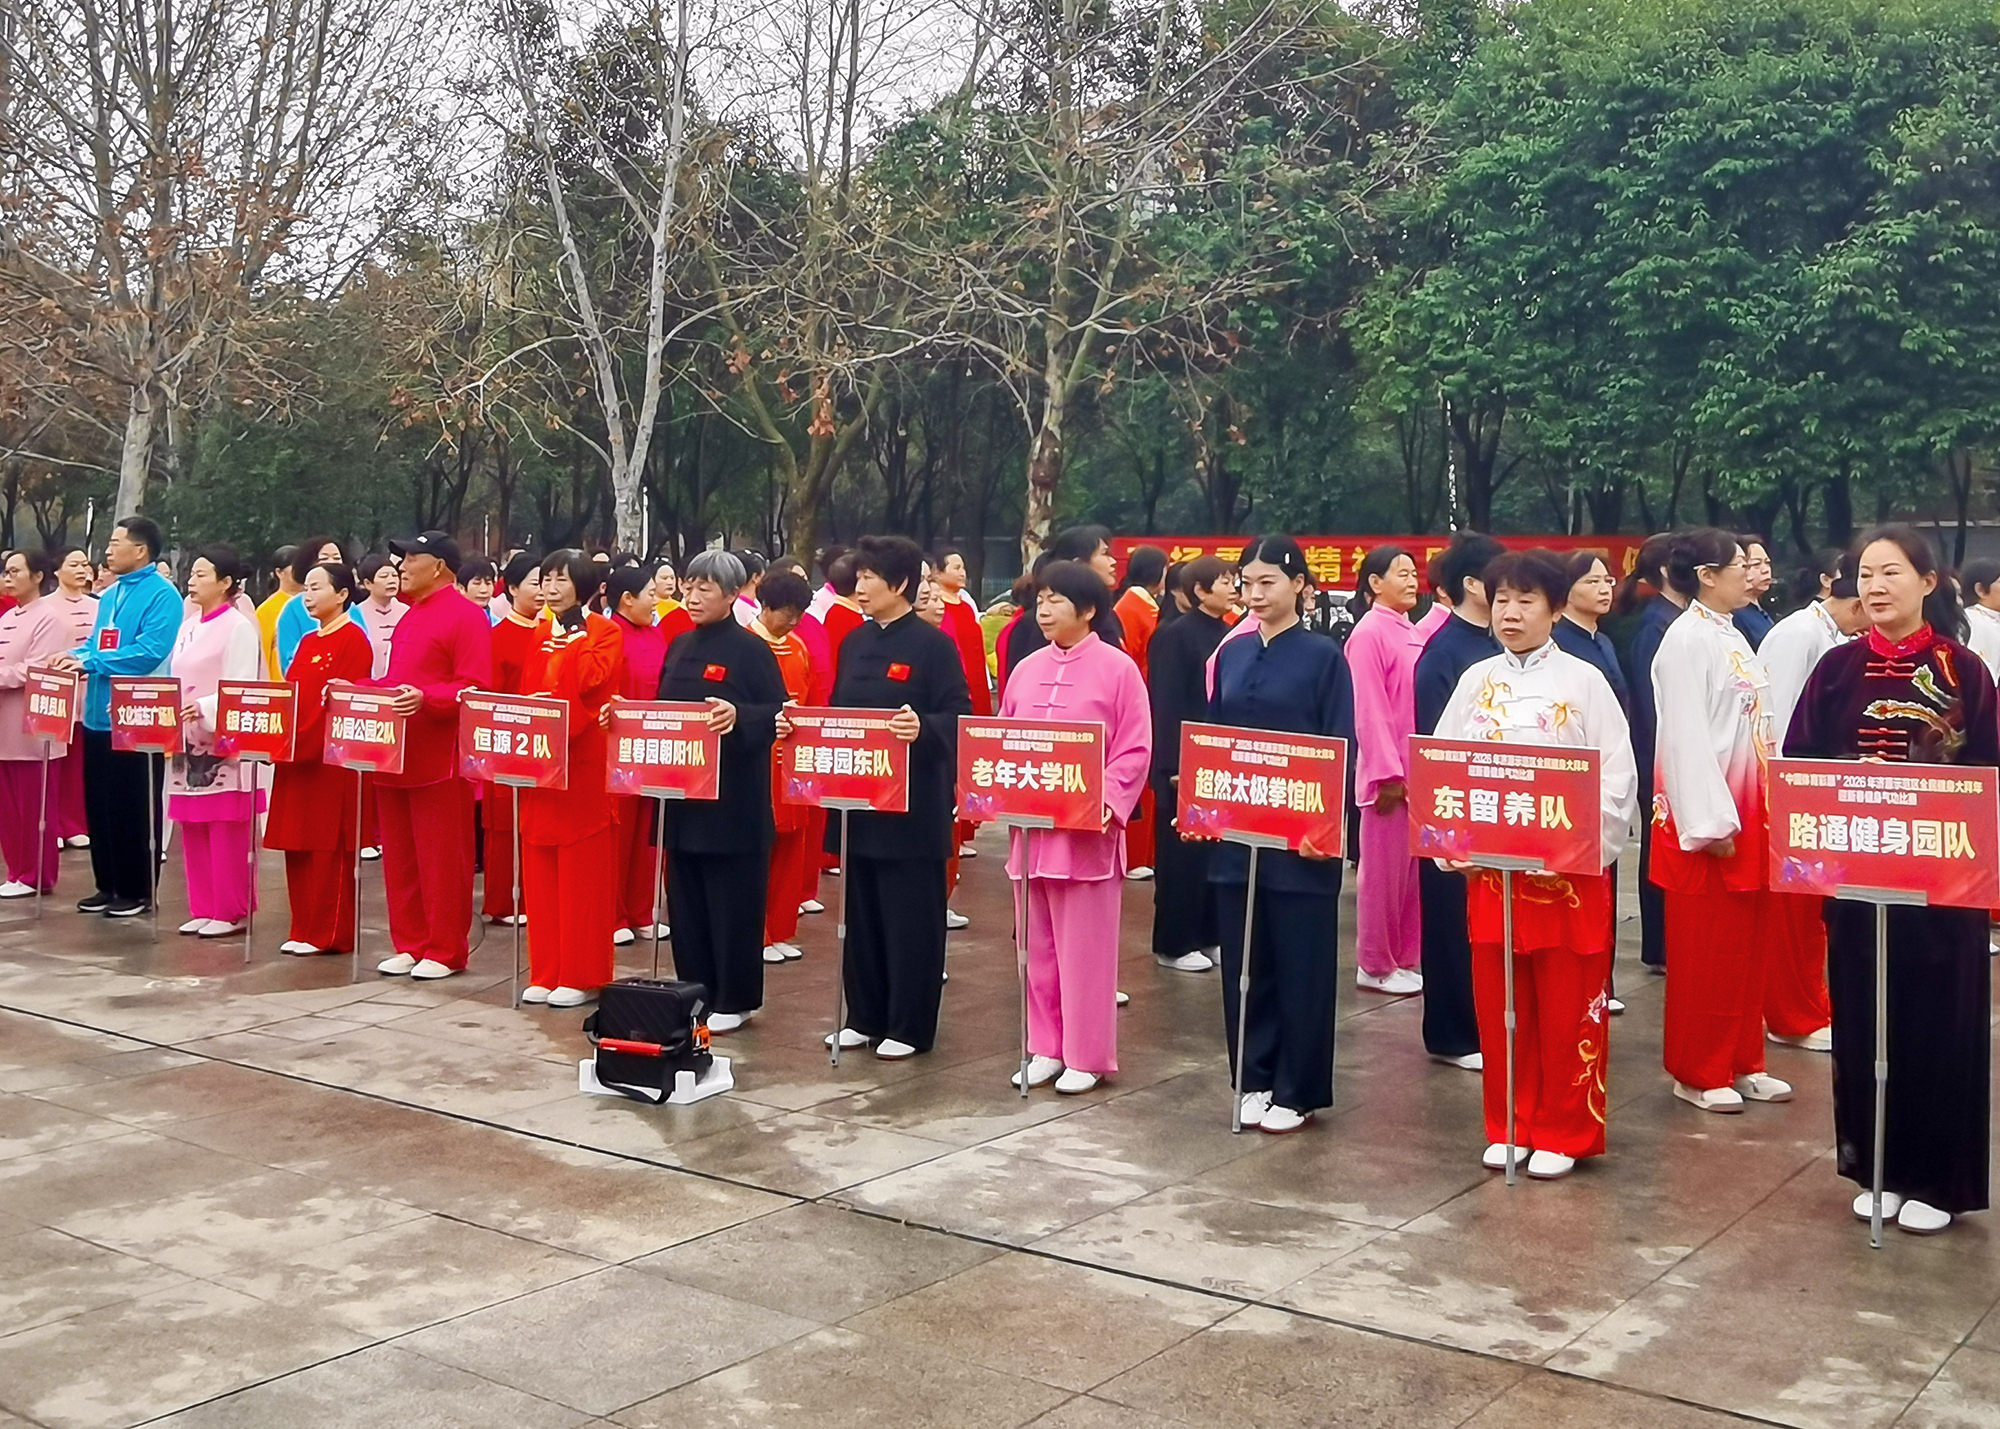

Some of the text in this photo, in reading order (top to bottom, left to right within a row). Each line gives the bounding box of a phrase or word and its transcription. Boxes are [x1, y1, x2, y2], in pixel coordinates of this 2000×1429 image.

[226, 709, 284, 734] 银杏苑队
[331, 715, 396, 745] 沁园公园2队
[794, 744, 894, 777] 望春园东队
[971, 757, 1087, 793] 老年大学队
[1194, 766, 1325, 814] 超然太极拳馆队
[1843, 775, 1866, 788] 2026
[1433, 785, 1573, 831] 东留养队
[1788, 812, 1976, 860] 路通健身园队
